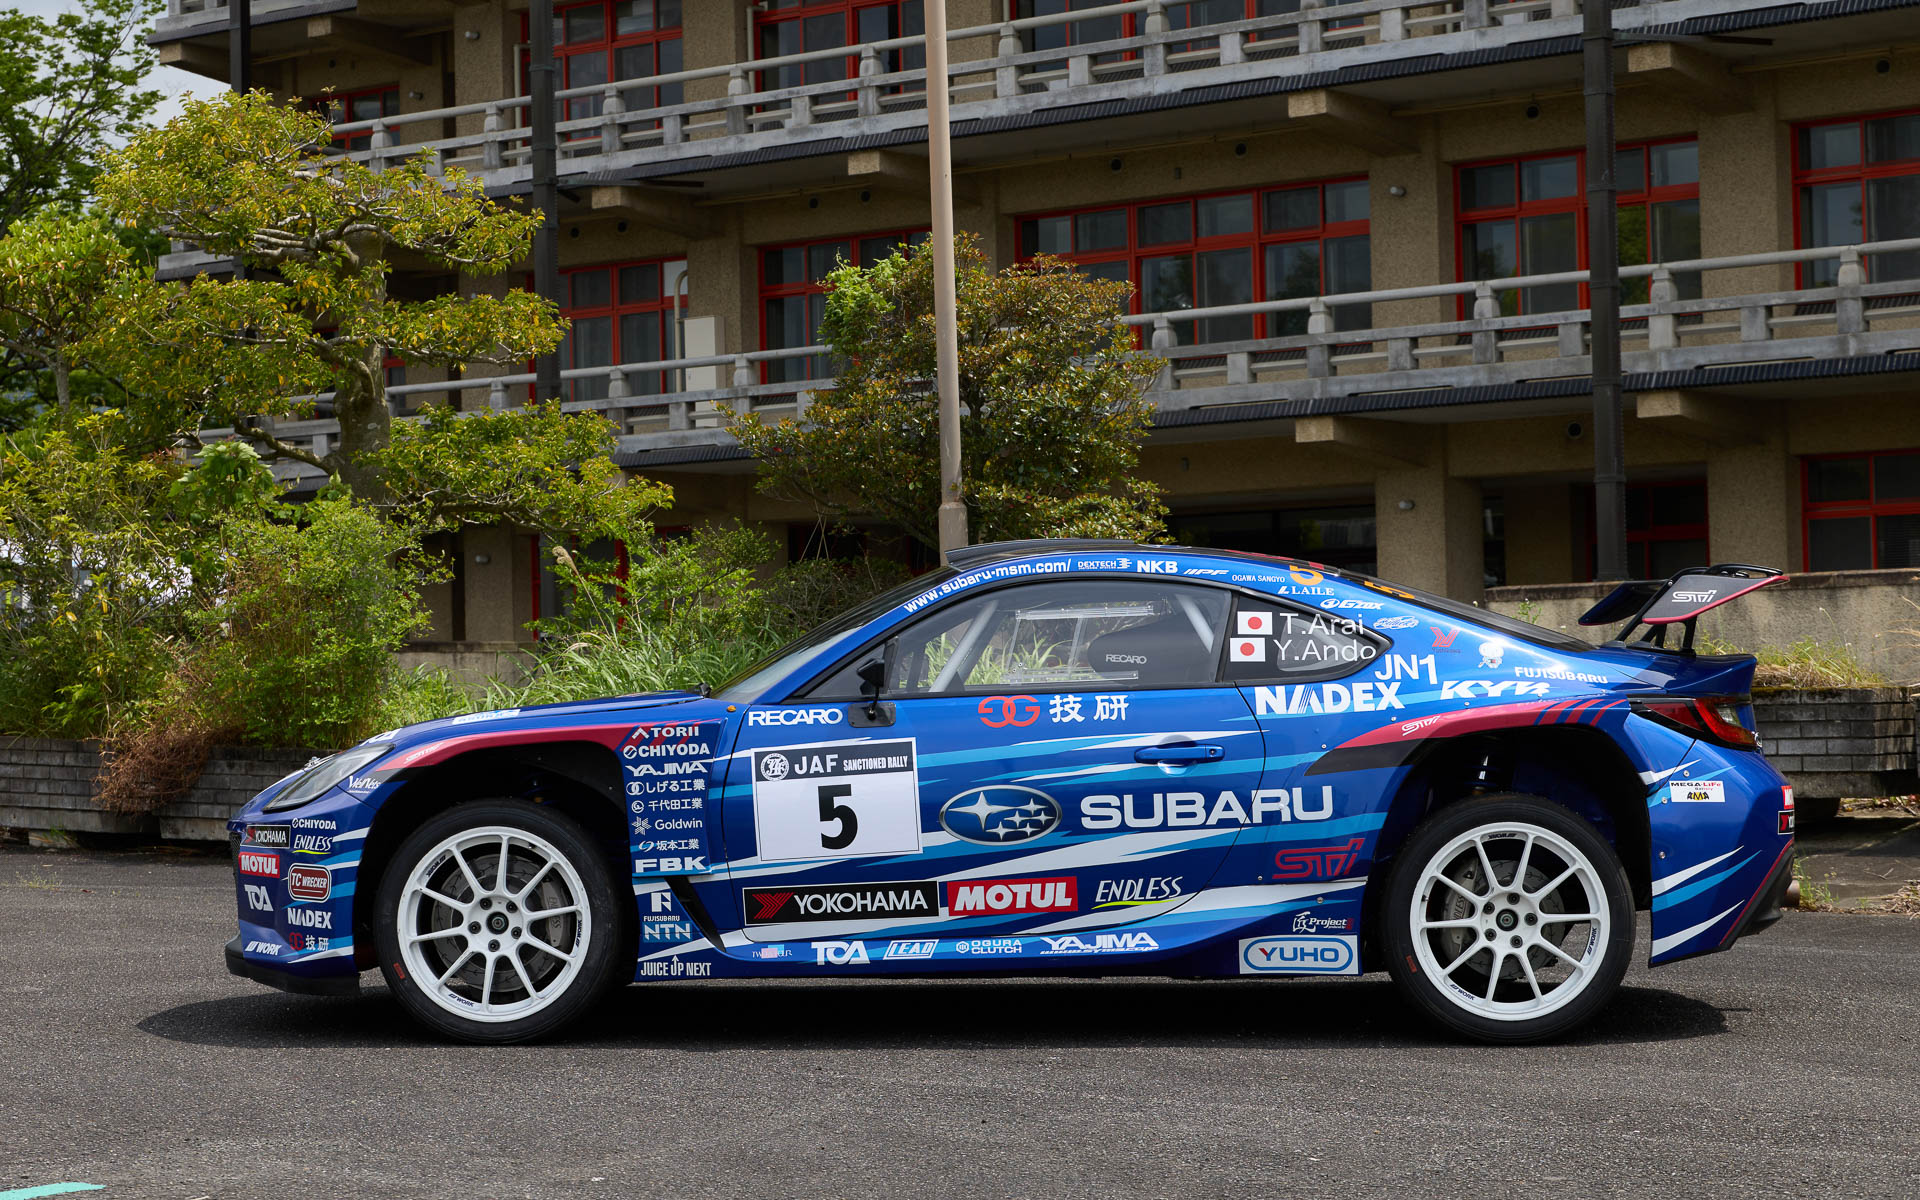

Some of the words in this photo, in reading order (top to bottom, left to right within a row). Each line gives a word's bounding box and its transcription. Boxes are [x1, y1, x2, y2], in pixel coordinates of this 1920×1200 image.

[1078, 560, 1117, 568] DEXTECH
[1137, 560, 1178, 573] NKB
[904, 559, 1071, 613] www.subaru-msm.com/
[1232, 574, 1257, 582] OGAWA
[1258, 575, 1285, 583] SANGYO
[1291, 586, 1335, 596] LAILE
[1279, 612, 1363, 636] T.Arai
[1273, 639, 1376, 661] Y.Ando
[1105, 654, 1147, 665] RECARO
[1375, 654, 1438, 685] JN1
[1514, 666, 1608, 684] FUJISUBARU
[1254, 681, 1405, 716] NADEX
[748, 708, 843, 727] RECARO
[1049, 694, 1130, 724] 技研
[650, 726, 700, 738] TORII
[638, 743, 711, 758] CHIYODA
[625, 761, 708, 777] YAJIMA
[794, 754, 839, 775] JAF
[843, 757, 887, 772] SANCTIONED
[887, 755, 908, 769] RALLY
[645, 778, 706, 793] しげる工業
[648, 798, 703, 812] 千代田工業
[1080, 785, 1333, 830] SUBARU
[298, 819, 337, 830] CHIYODA
[654, 818, 703, 831] Goldwin
[817, 783, 859, 850] 5
[255, 830, 287, 843] YOKOHAMA
[293, 834, 332, 851] ENDLESS
[656, 838, 700, 851] 坂本工業
[241, 854, 278, 875] MOTUL
[634, 855, 707, 873] FBK
[291, 872, 302, 887] TC
[302, 877, 328, 889] WRECKER
[244, 884, 274, 912] TOA
[954, 882, 1072, 912] MOTUL
[1095, 876, 1184, 903] ENDLESS
[794, 889, 928, 915] YOKOHAMA
[287, 907, 333, 930] NADEX
[1309, 917, 1347, 928] Project
[644, 923, 691, 940] NTN
[256, 942, 282, 956] WORK
[888, 942, 934, 956] LEAD
[971, 939, 1022, 947] OGURA
[1040, 932, 1159, 951] YAJIMA
[811, 940, 871, 965] TOA
[1258, 947, 1340, 963] YUHO
[640, 961, 669, 976] JUICE
[671, 955, 684, 976] UP
[686, 962, 712, 976] NEXT
